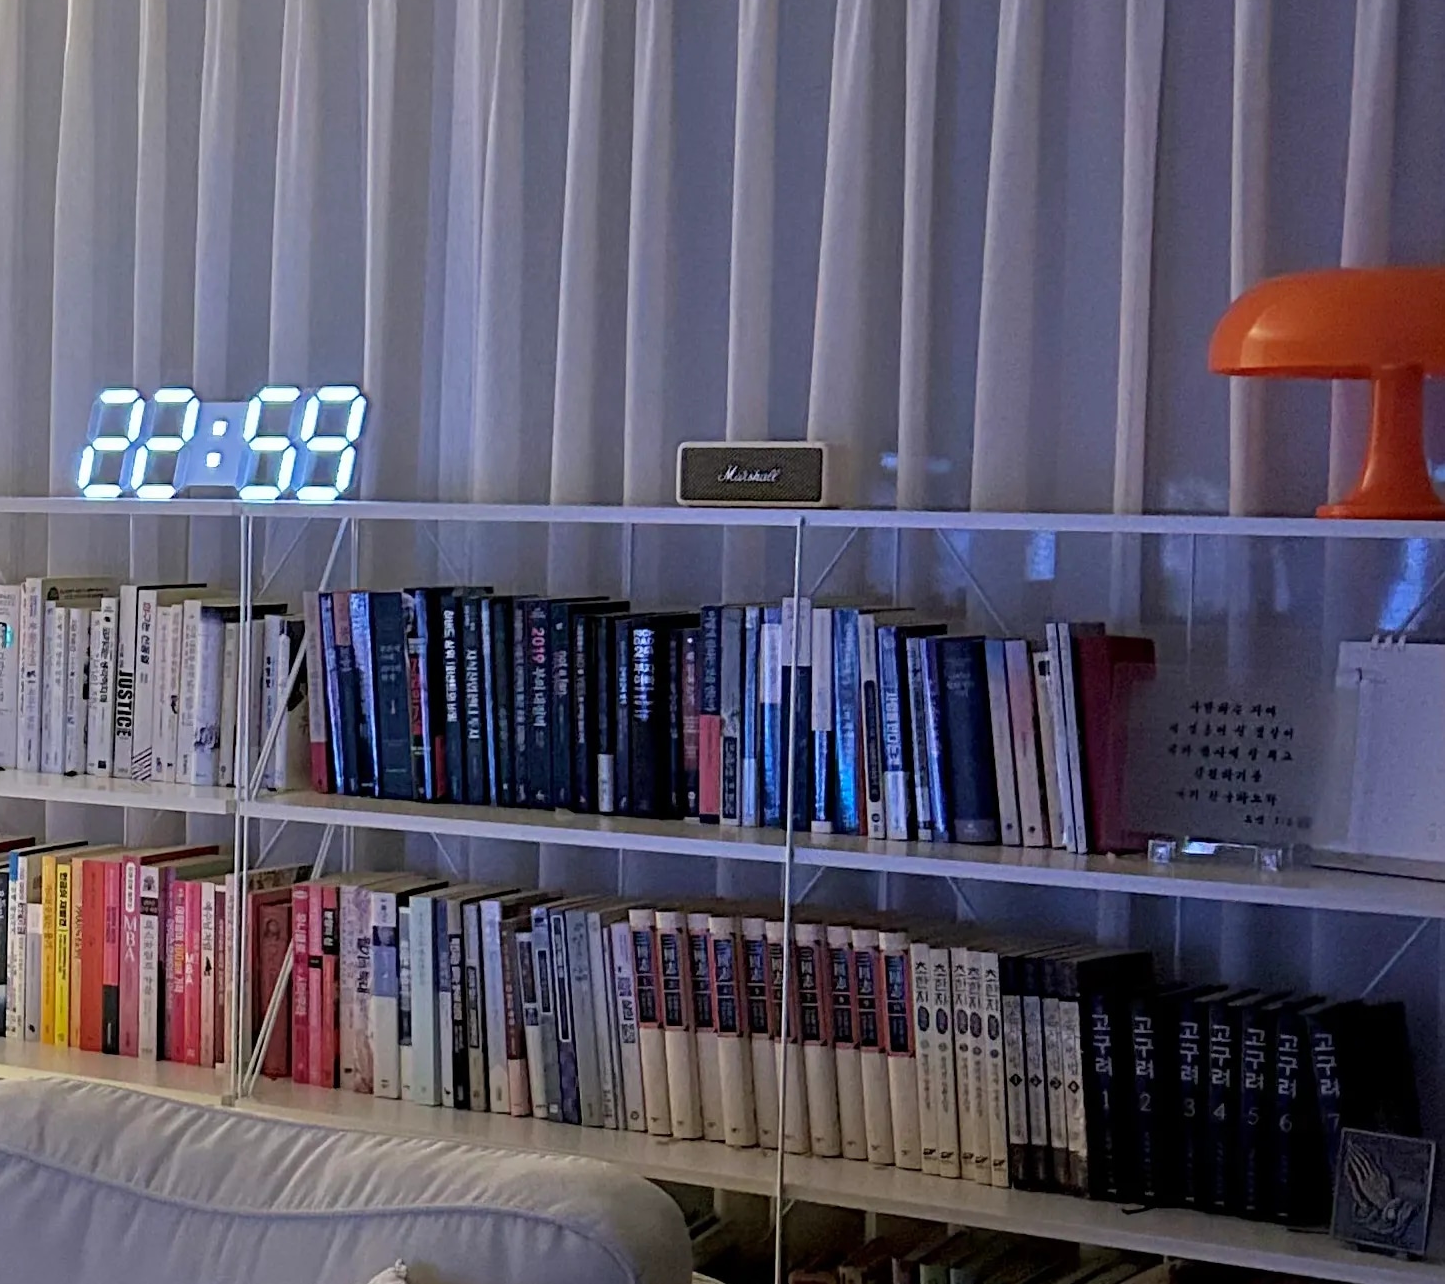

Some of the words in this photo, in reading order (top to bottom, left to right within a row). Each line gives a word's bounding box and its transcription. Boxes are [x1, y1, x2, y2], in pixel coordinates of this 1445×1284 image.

[77, 386, 366, 501] 22:59
[717, 465, 781, 483] Marshall
[531, 626, 546, 664] 2019
[117, 670, 133, 737] JUSTICE
[122, 914, 138, 963] MBA
[1092, 1014, 1113, 1076] 고구려
[1134, 1016, 1154, 1080] 고구려
[1179, 1021, 1200, 1086] 고구려
[1211, 1024, 1232, 1088] 고구려
[1244, 1028, 1267, 1091] 고구려
[1277, 1034, 1299, 1099] 고구려
[1314, 1033, 1340, 1096] 고구려
[1101, 1089, 1109, 1111] 1
[1139, 1093, 1152, 1113] 2
[1183, 1097, 1196, 1118] 3
[1212, 1102, 1226, 1121] 4
[1247, 1107, 1260, 1126] 5
[1278, 1113, 1293, 1133] 6
